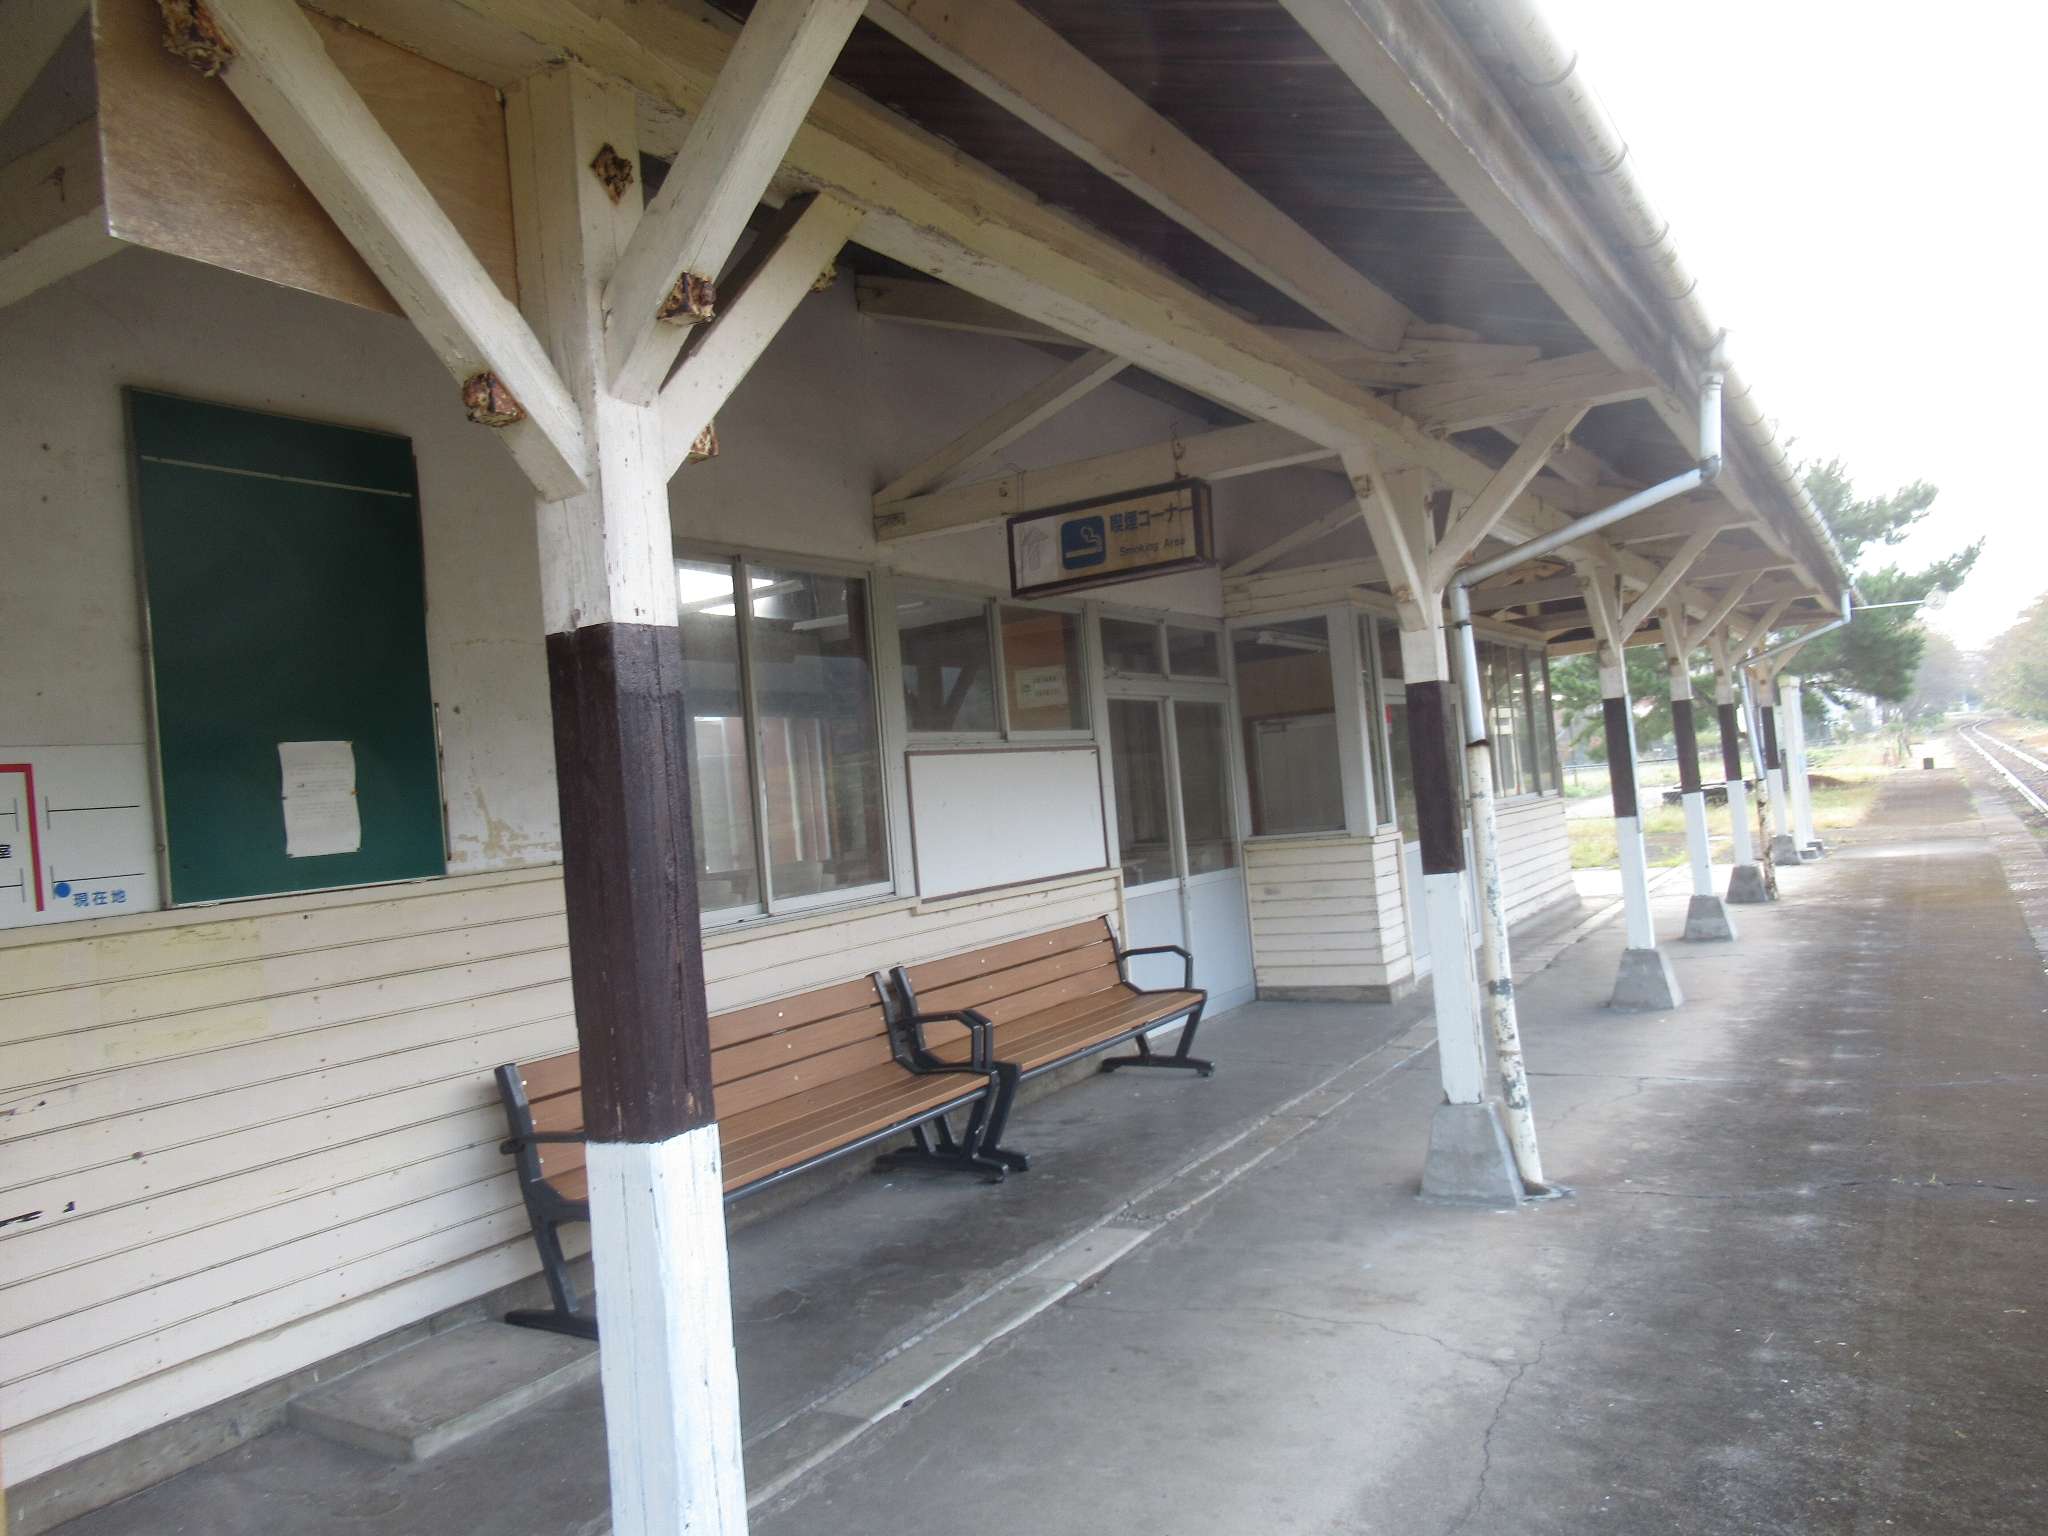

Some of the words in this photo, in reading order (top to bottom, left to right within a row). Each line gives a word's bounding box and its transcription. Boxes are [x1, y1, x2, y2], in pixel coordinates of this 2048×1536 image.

[1119, 542, 1160, 557] Smoking
[1164, 536, 1186, 549] Area
[73, 889, 128, 907] 現在地
